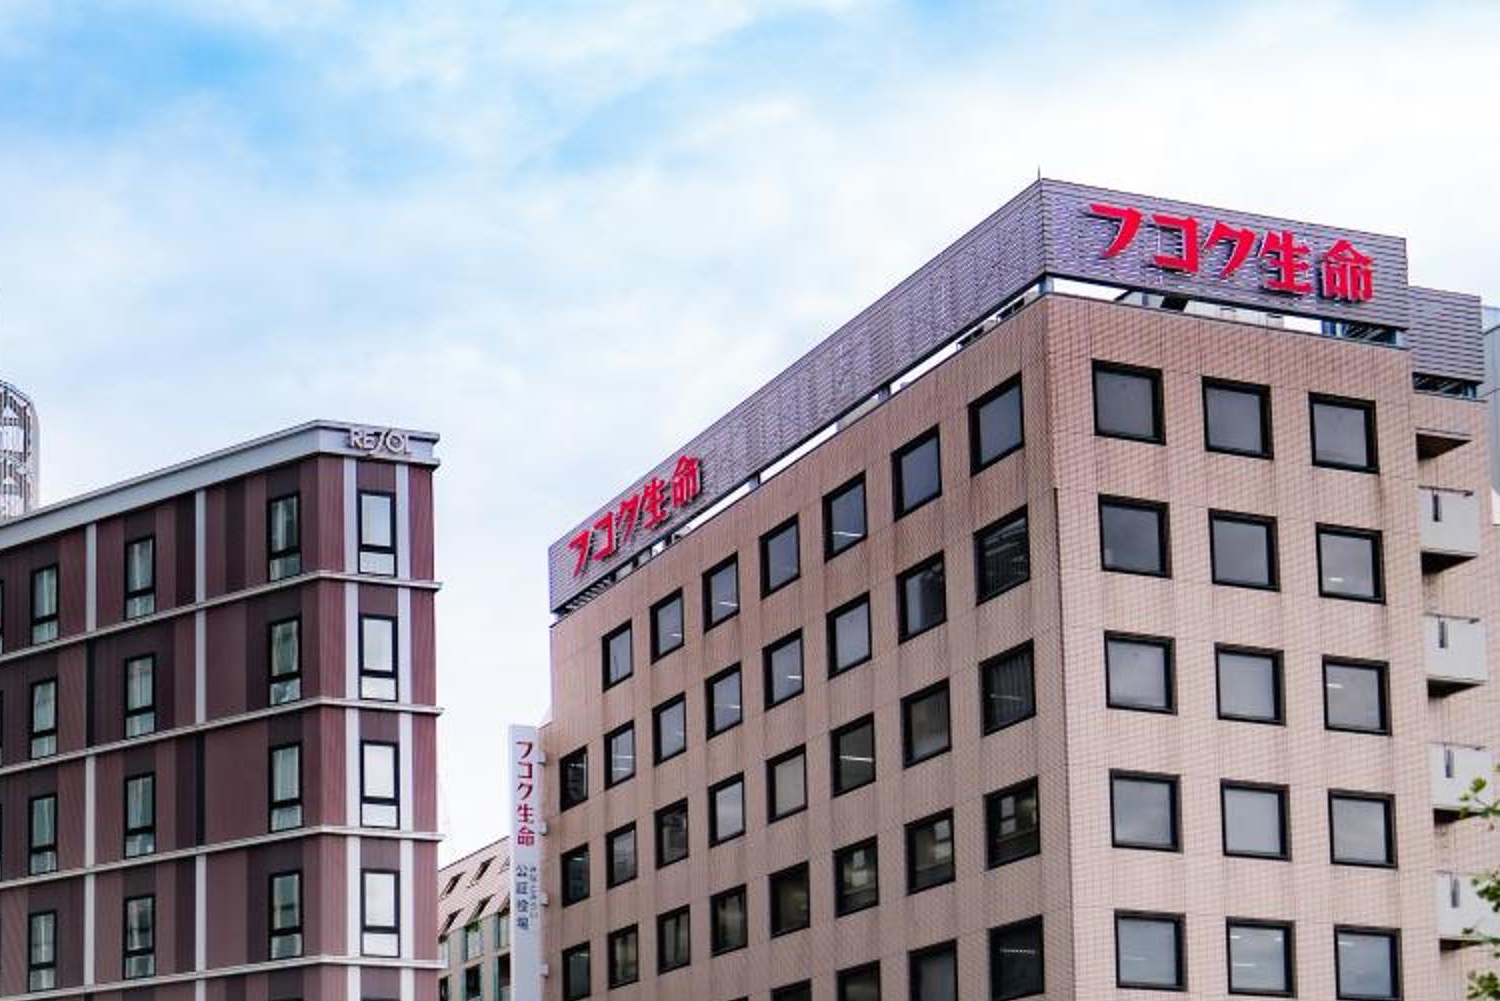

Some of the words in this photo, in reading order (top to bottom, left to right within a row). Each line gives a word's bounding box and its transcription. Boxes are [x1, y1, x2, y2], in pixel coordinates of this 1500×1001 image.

[1090, 202, 1373, 301] フコク生命
[350, 427, 411, 456] RESOL
[567, 454, 699, 578] フコク生命
[515, 741, 535, 847] フコク生命
